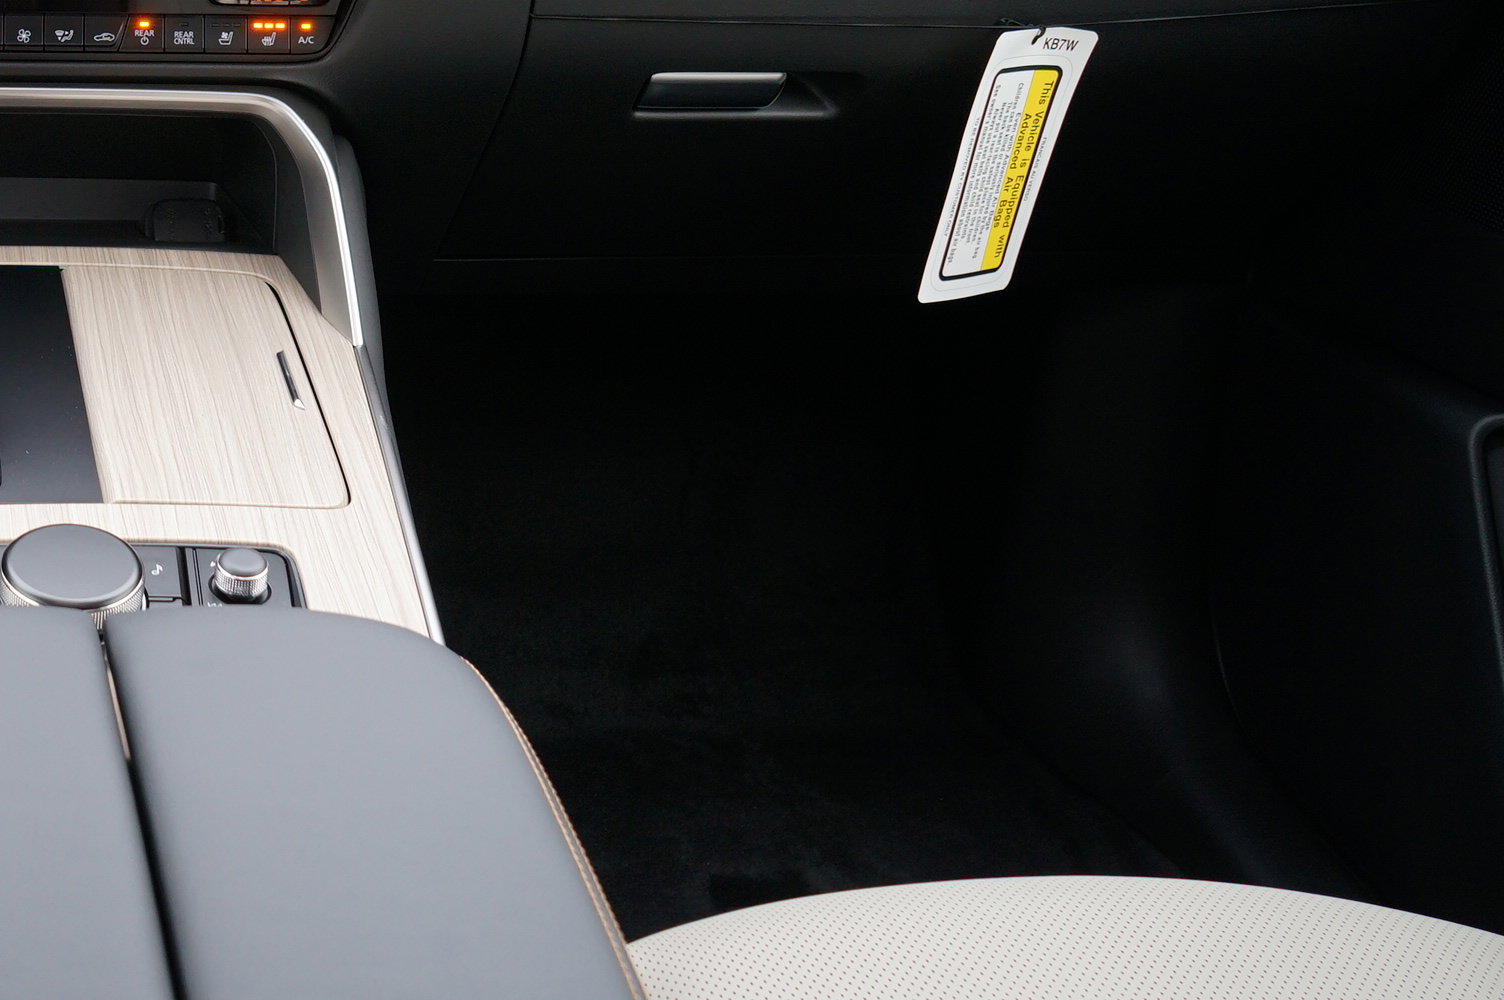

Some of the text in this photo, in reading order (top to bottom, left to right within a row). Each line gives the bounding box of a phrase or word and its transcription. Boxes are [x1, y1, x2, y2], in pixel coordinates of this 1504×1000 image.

[298, 36, 315, 44] A/C
[1043, 37, 1079, 52] KB7W
[991, 113, 1032, 229] Advanced Air Bags
[994, 81, 1054, 258] This Vehicle is Equipped with
